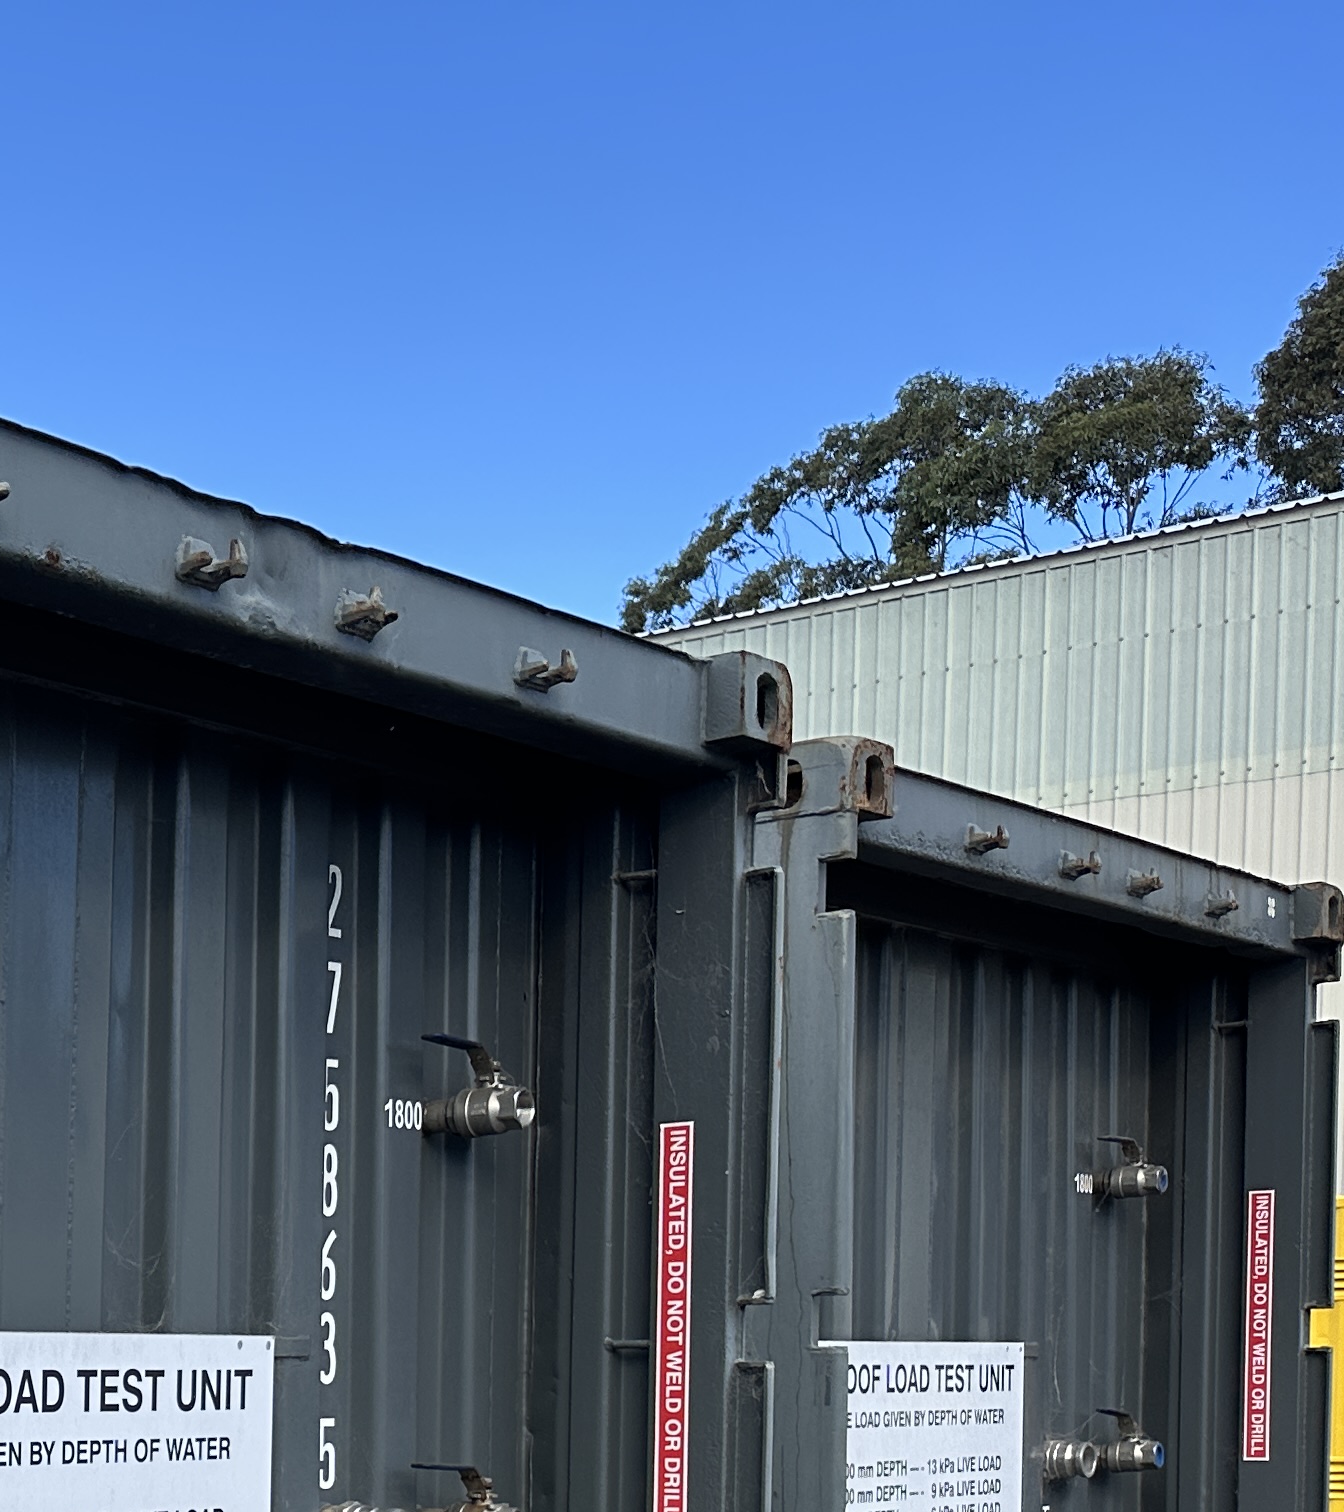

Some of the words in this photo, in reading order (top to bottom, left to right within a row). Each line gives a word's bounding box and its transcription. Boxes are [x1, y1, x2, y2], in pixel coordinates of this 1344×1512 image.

[384, 1098, 423, 1131] 1800
[664, 1129, 687, 1255] INSULATED,
[1074, 1172, 1094, 1194] 1800
[1252, 1194, 1269, 1280] INSULATED,
[667, 1261, 685, 1294] DO
[1253, 1282, 1267, 1305] DO
[666, 1300, 684, 1345] NOT
[1253, 1309, 1267, 1339] NOT
[886, 1364, 930, 1394] LOAD
[934, 1364, 975, 1393] TEST
[979, 1364, 1015, 1393] UNIT
[1252, 1342, 1266, 1385] WELD
[76, 1368, 165, 1413] TEST
[176, 1369, 253, 1412] UNIT
[665, 1350, 683, 1413] WELD
[1252, 1388, 1265, 1410] OR
[664, 1419, 682, 1451] OR
[855, 1412, 881, 1429] LOAD
[883, 1411, 912, 1428] GIVEN
[913, 1411, 926, 1427] BY
[928, 1410, 958, 1427] DEPTH
[959, 1410, 973, 1426] OF
[974, 1409, 1005, 1425] WATER
[1251, 1413, 1264, 1456] DRILL
[29, 1440, 56, 1466] BY
[61, 1439, 127, 1465] DEPTH
[134, 1438, 161, 1463] OF
[165, 1436, 231, 1462] WATER
[857, 1466, 874, 1478] mm
[876, 1461, 908, 1478] DEPTH
[927, 1459, 937, 1475] 13
[939, 1458, 955, 1474] kPa
[957, 1457, 976, 1473] LIVE
[978, 1456, 1002, 1472] LOAD
[857, 1491, 874, 1503] mm
[876, 1485, 907, 1503] DEPTH
[931, 1483, 937, 1499] 9
[939, 1482, 955, 1497] kPa
[956, 1480, 976, 1497] LIVE
[977, 1479, 1002, 1496] LOAD
